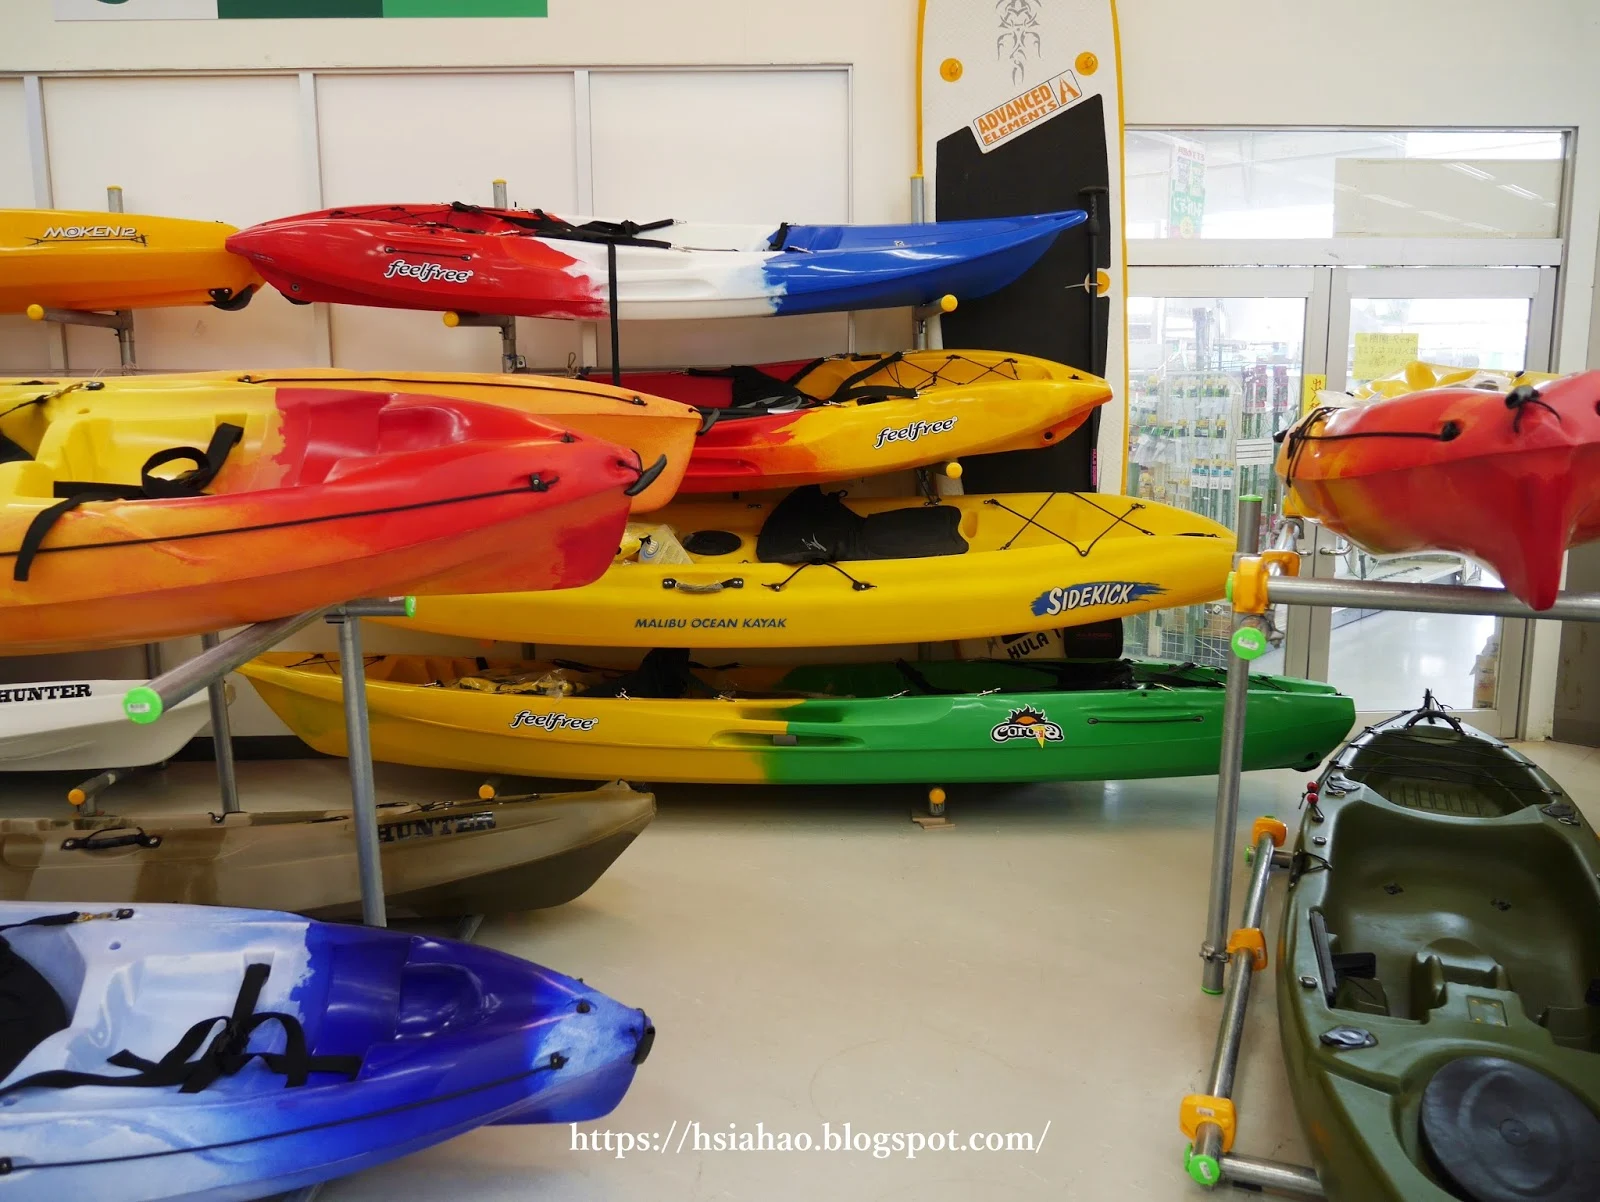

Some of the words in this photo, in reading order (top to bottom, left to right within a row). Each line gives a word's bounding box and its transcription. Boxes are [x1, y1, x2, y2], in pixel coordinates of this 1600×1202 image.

[977, 85, 1052, 134] ADVANCED
[982, 100, 1058, 145] ELEMENTS
[384, 259, 468, 283] feelfree
[873, 419, 954, 449] feelfree
[1046, 584, 1134, 615] SIDEKICK
[634, 618, 687, 628] MALIBU
[691, 618, 738, 628] OCEAN
[742, 618, 788, 628] KAYAK
[1006, 632, 1050, 660] HULA
[0, 684, 92, 702] HUNTER
[509, 709, 594, 731] feelfree
[377, 812, 497, 842] HUNTER
